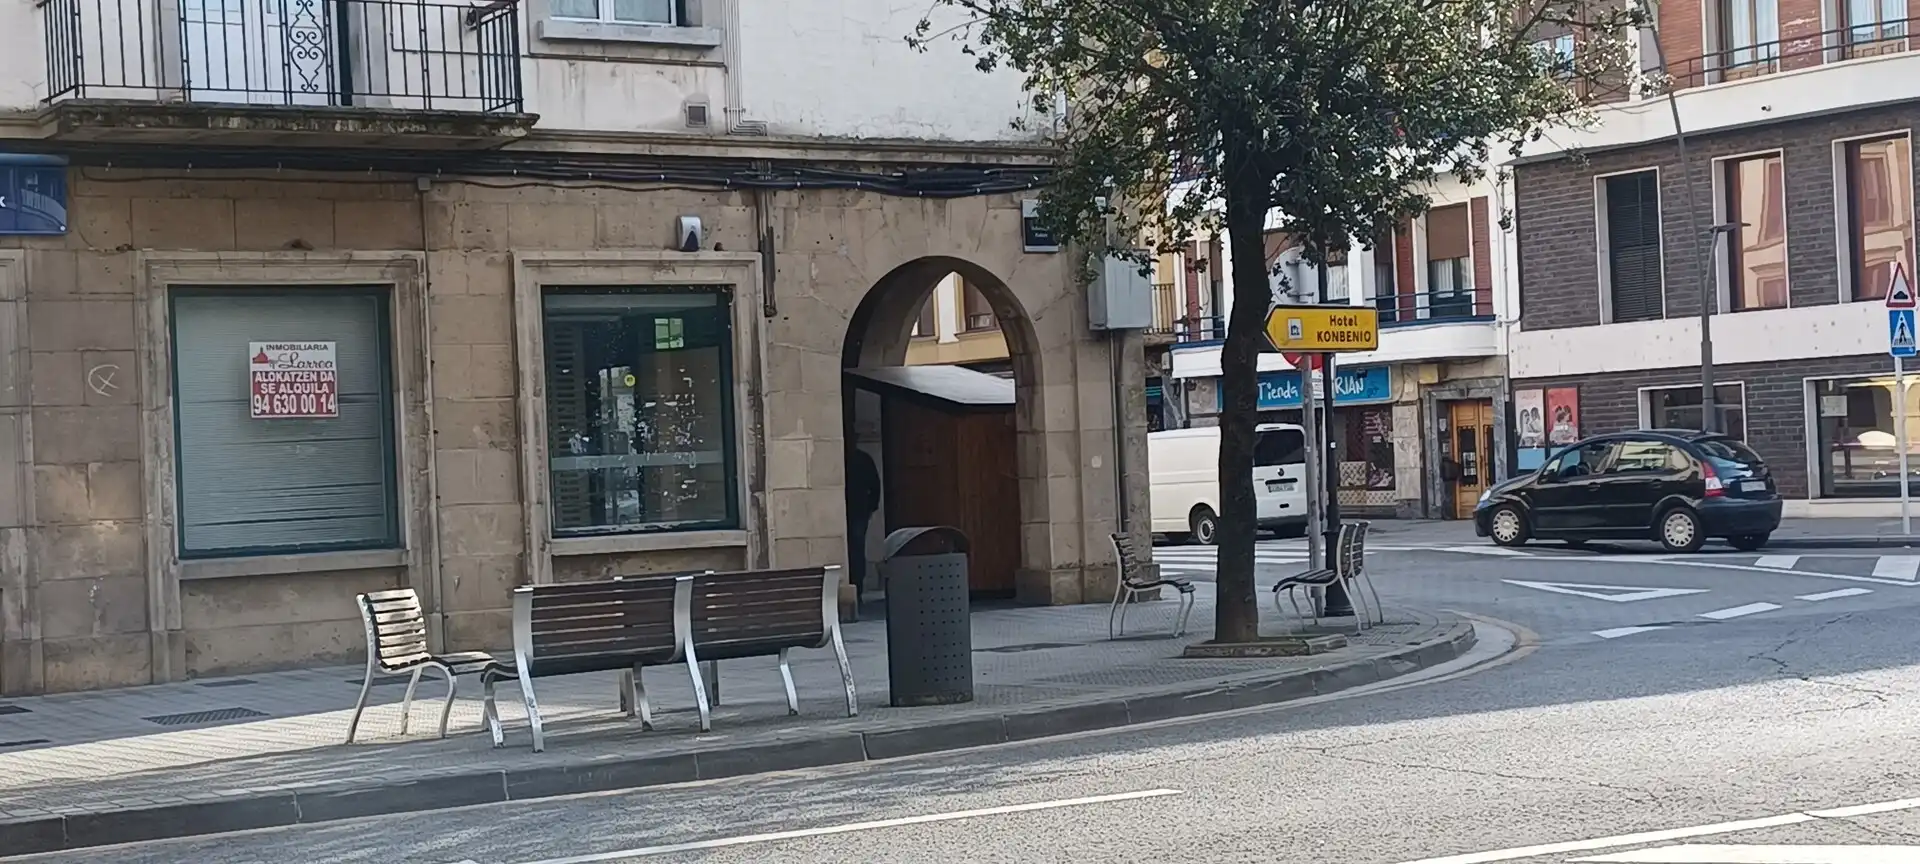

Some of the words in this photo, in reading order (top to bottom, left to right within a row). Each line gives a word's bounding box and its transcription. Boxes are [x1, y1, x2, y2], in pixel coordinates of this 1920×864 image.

[1329, 315, 1358, 327] Hotel
[1316, 331, 1371, 343] KONBENIO
[254, 371, 318, 383] ALOKATZEN
[320, 371, 335, 383] DA
[260, 383, 276, 394] SE
[278, 383, 329, 394] ALQUILA
[1257, 380, 1299, 401] Tienda
[1334, 376, 1364, 395] RIAN
[253, 394, 271, 414] 94
[273, 394, 297, 414] 630
[300, 393, 317, 414] 00
[320, 393, 336, 414] 14
